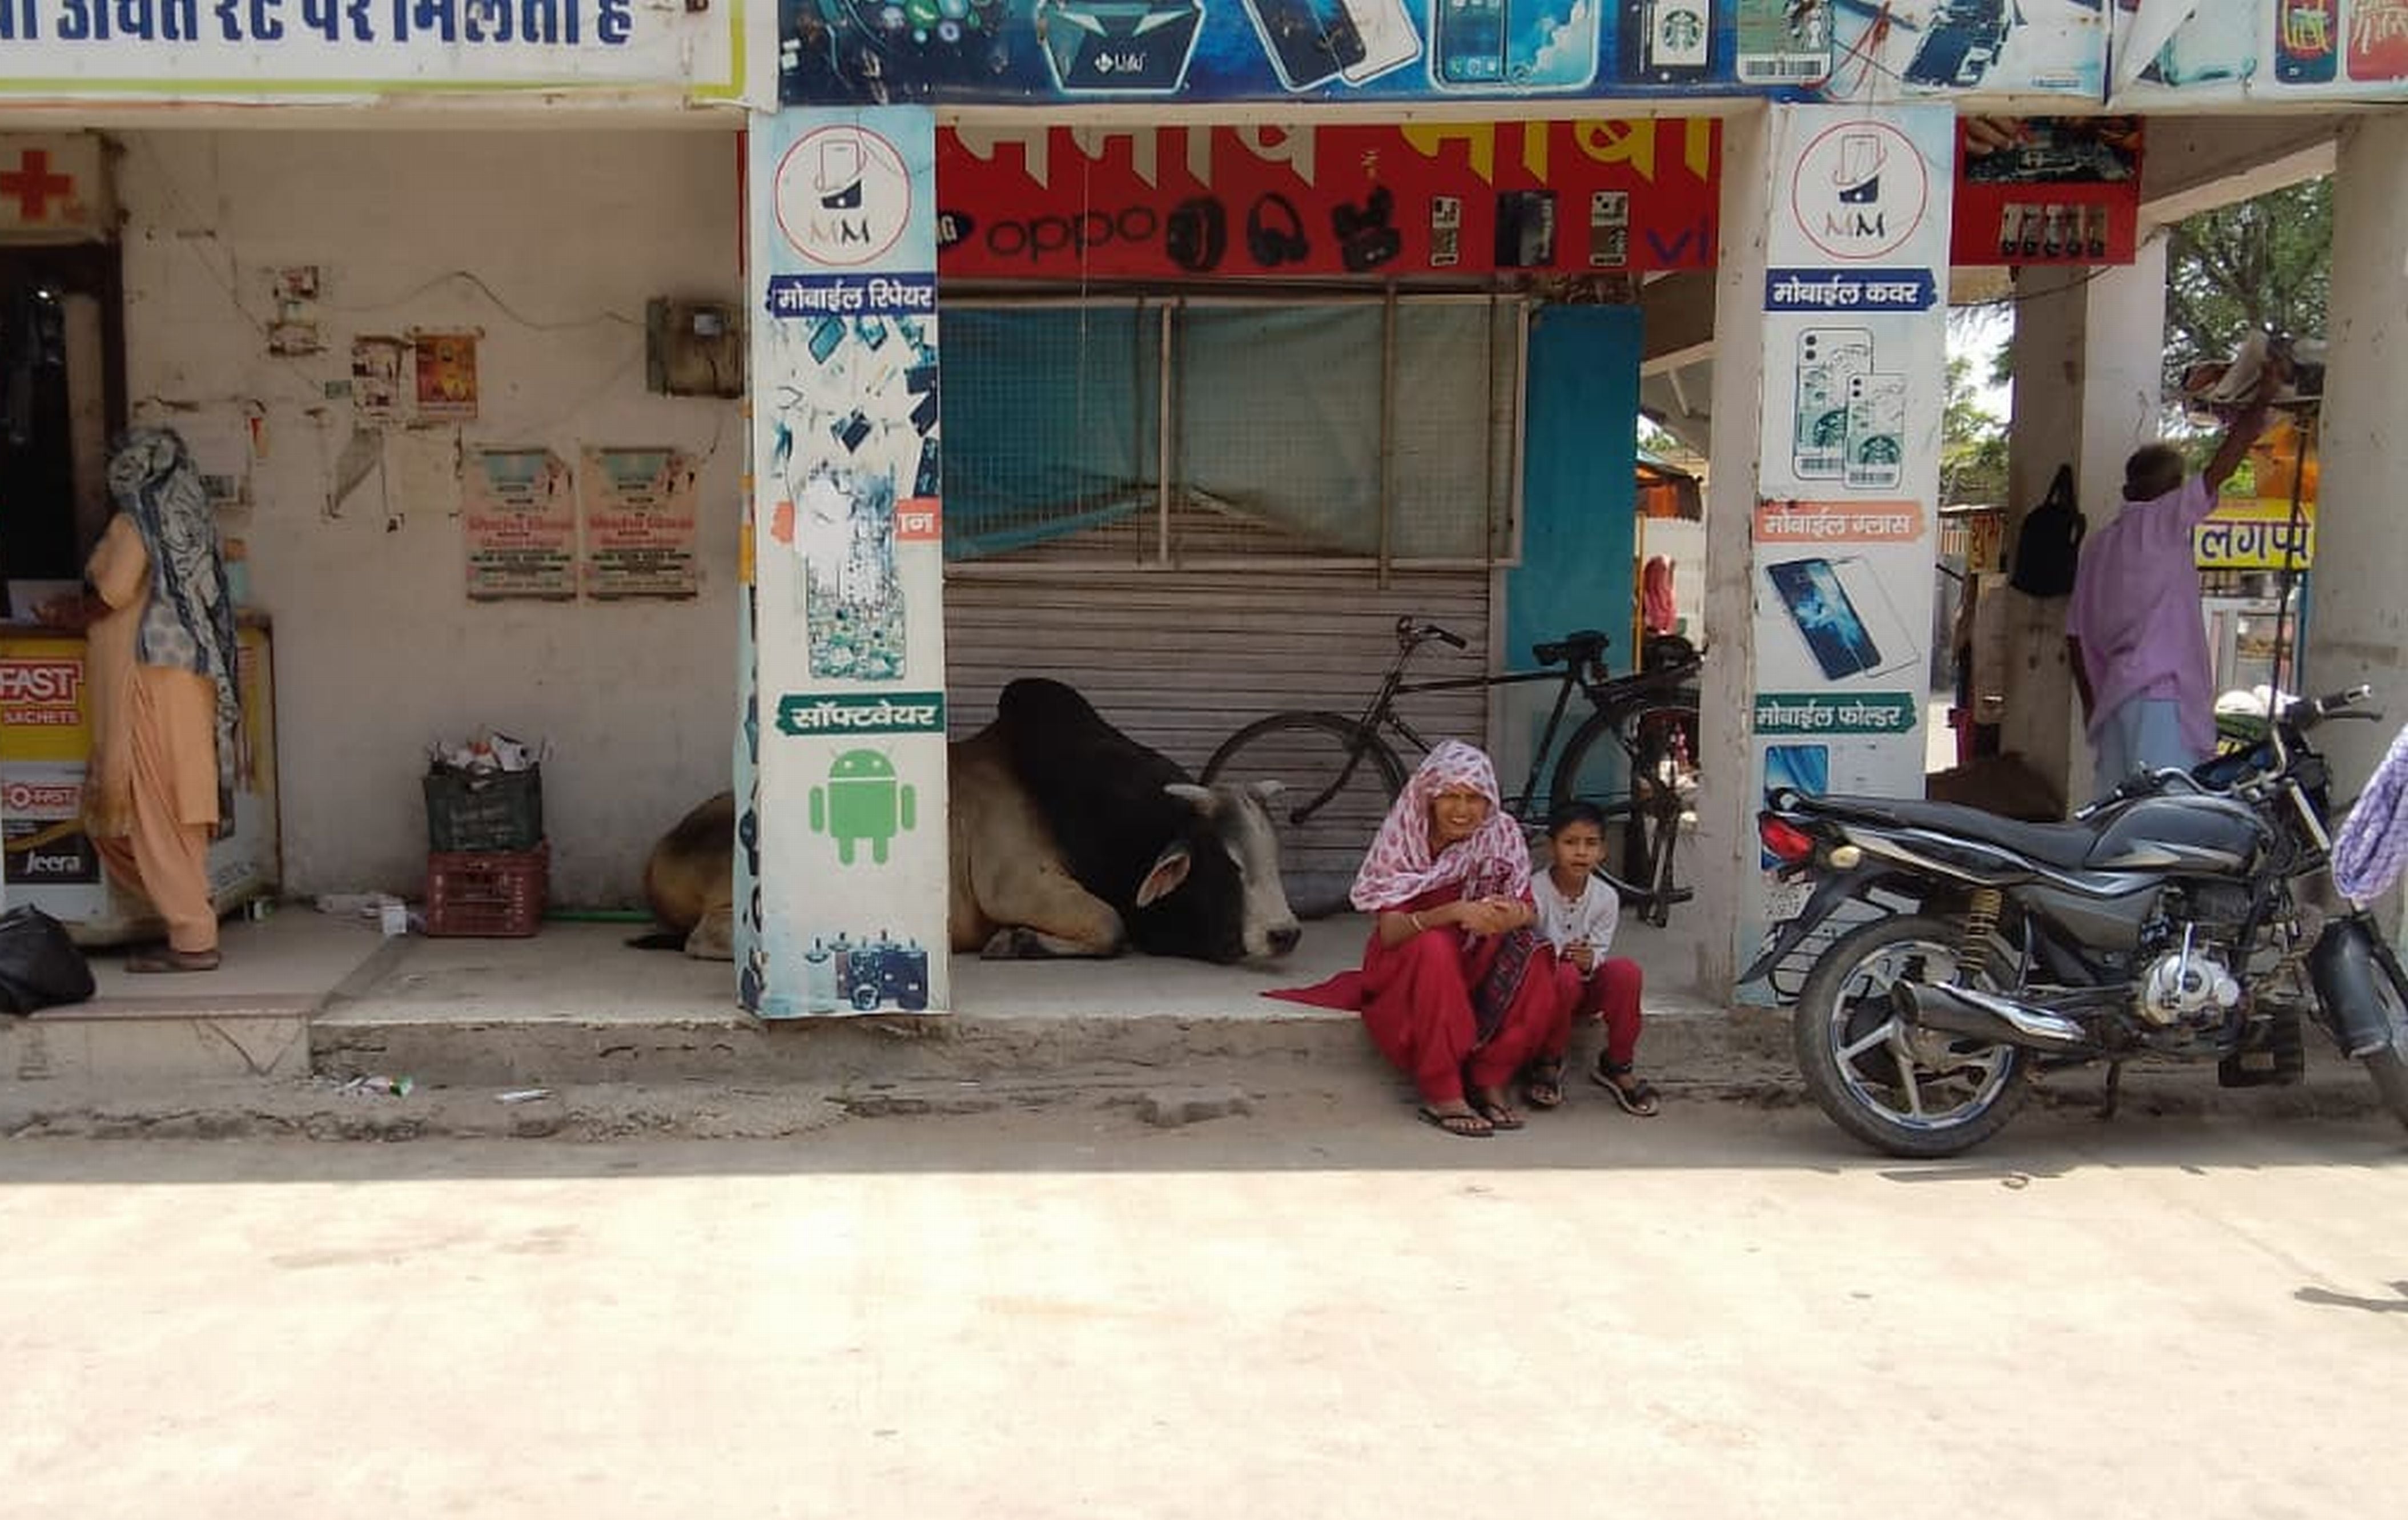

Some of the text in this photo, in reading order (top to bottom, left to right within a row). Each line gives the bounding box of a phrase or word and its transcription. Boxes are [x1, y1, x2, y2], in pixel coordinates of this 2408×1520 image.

[869, 278, 933, 308] रिपेयर
[1865, 282, 1920, 303] कवर
[0, 668, 74, 696] FAST
[26, 850, 81, 875] Jeera
